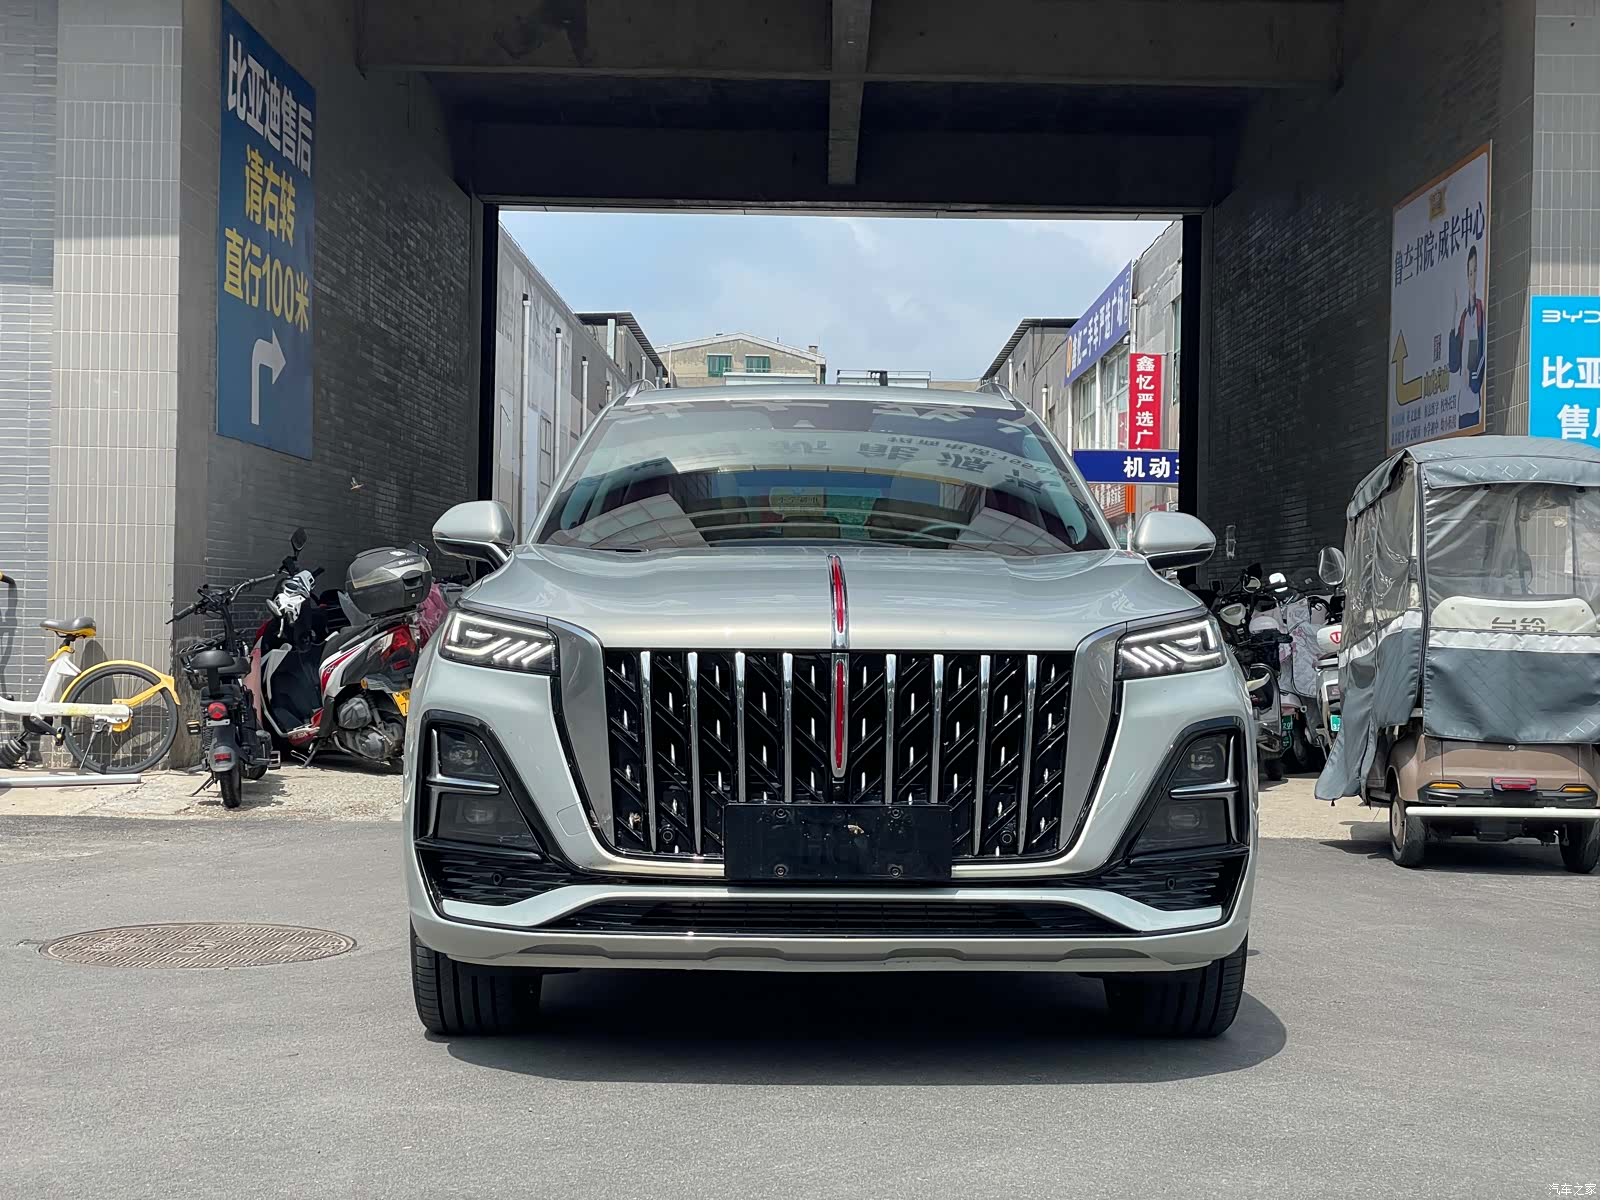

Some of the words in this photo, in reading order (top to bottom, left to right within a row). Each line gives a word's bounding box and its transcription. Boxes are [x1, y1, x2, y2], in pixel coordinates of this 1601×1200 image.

[228, 34, 312, 178] 比亚迪售后
[245, 144, 296, 247] 请右转
[224, 227, 309, 333] 直行100米
[1542, 310, 1600, 323] BYD
[1135, 356, 1155, 450] 鑫忆严选广
[1124, 455, 1180, 478] 机动
